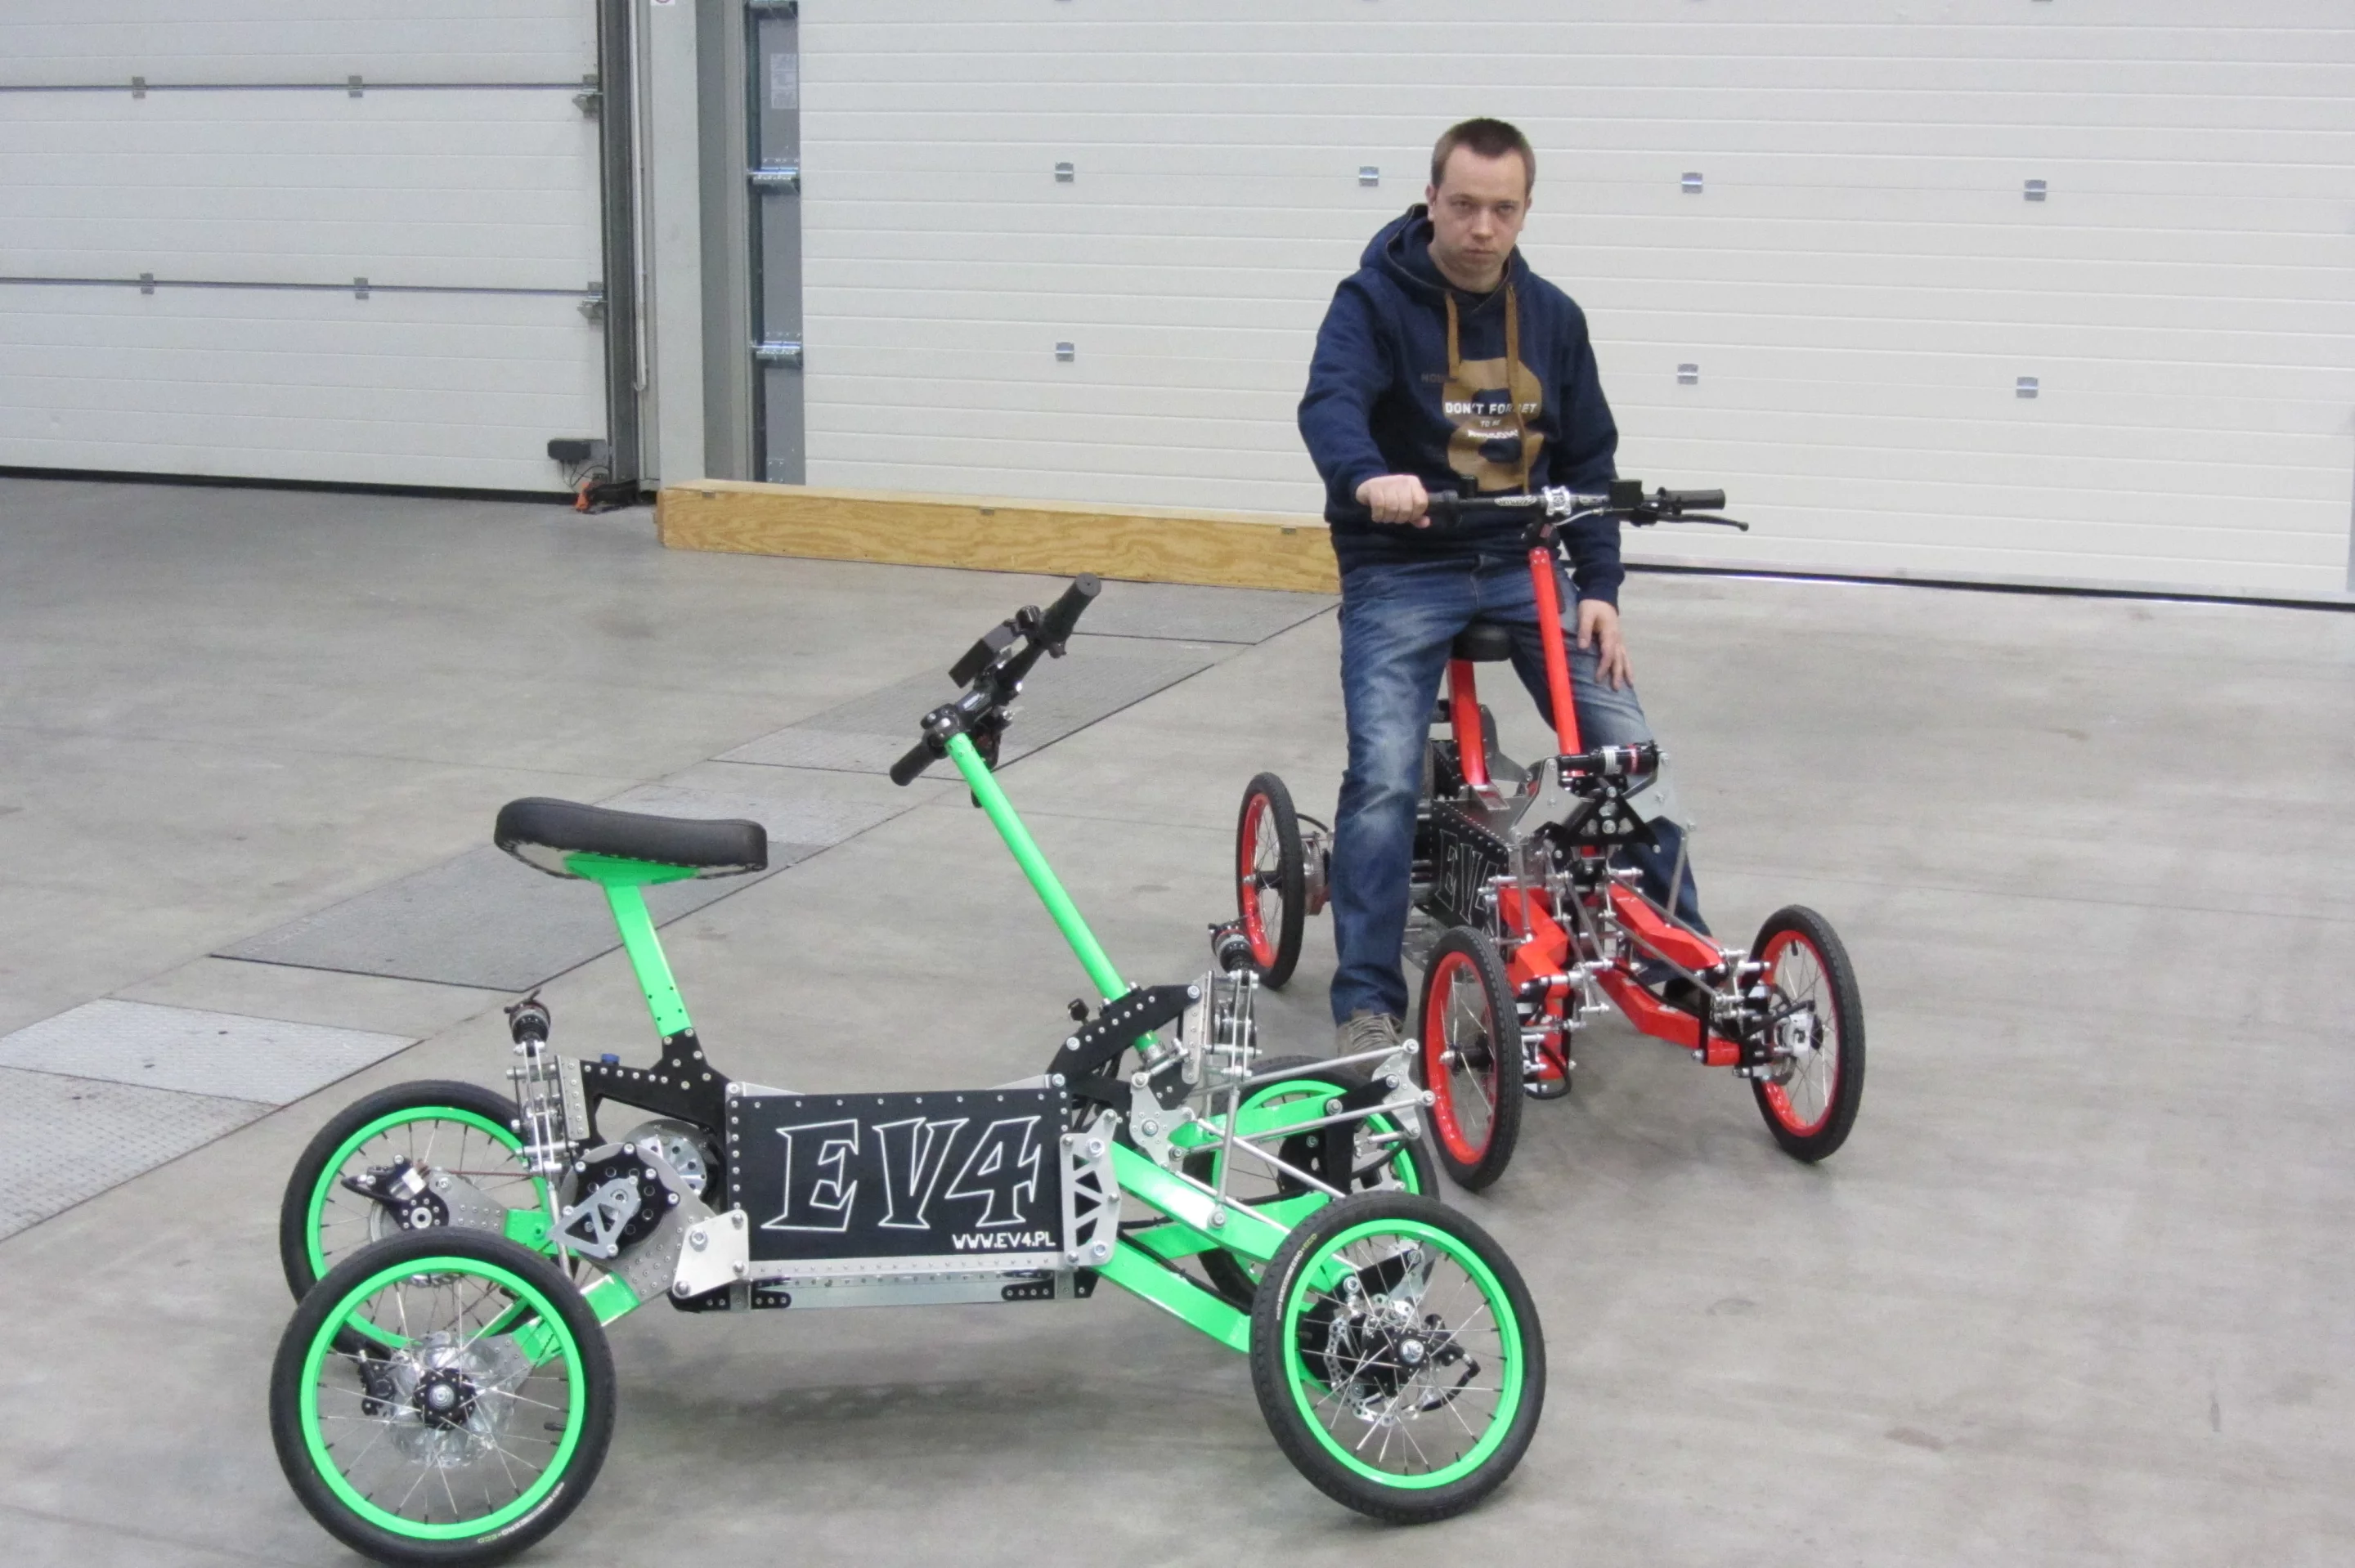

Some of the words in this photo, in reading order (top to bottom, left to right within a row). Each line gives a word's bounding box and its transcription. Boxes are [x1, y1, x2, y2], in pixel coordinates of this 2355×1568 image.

[1445, 402, 1485, 414] DON'T
[1488, 403, 1537, 414] FORET
[761, 1115, 1042, 1231] EV4
[952, 1231, 1056, 1249] WWW.EV4.PL
